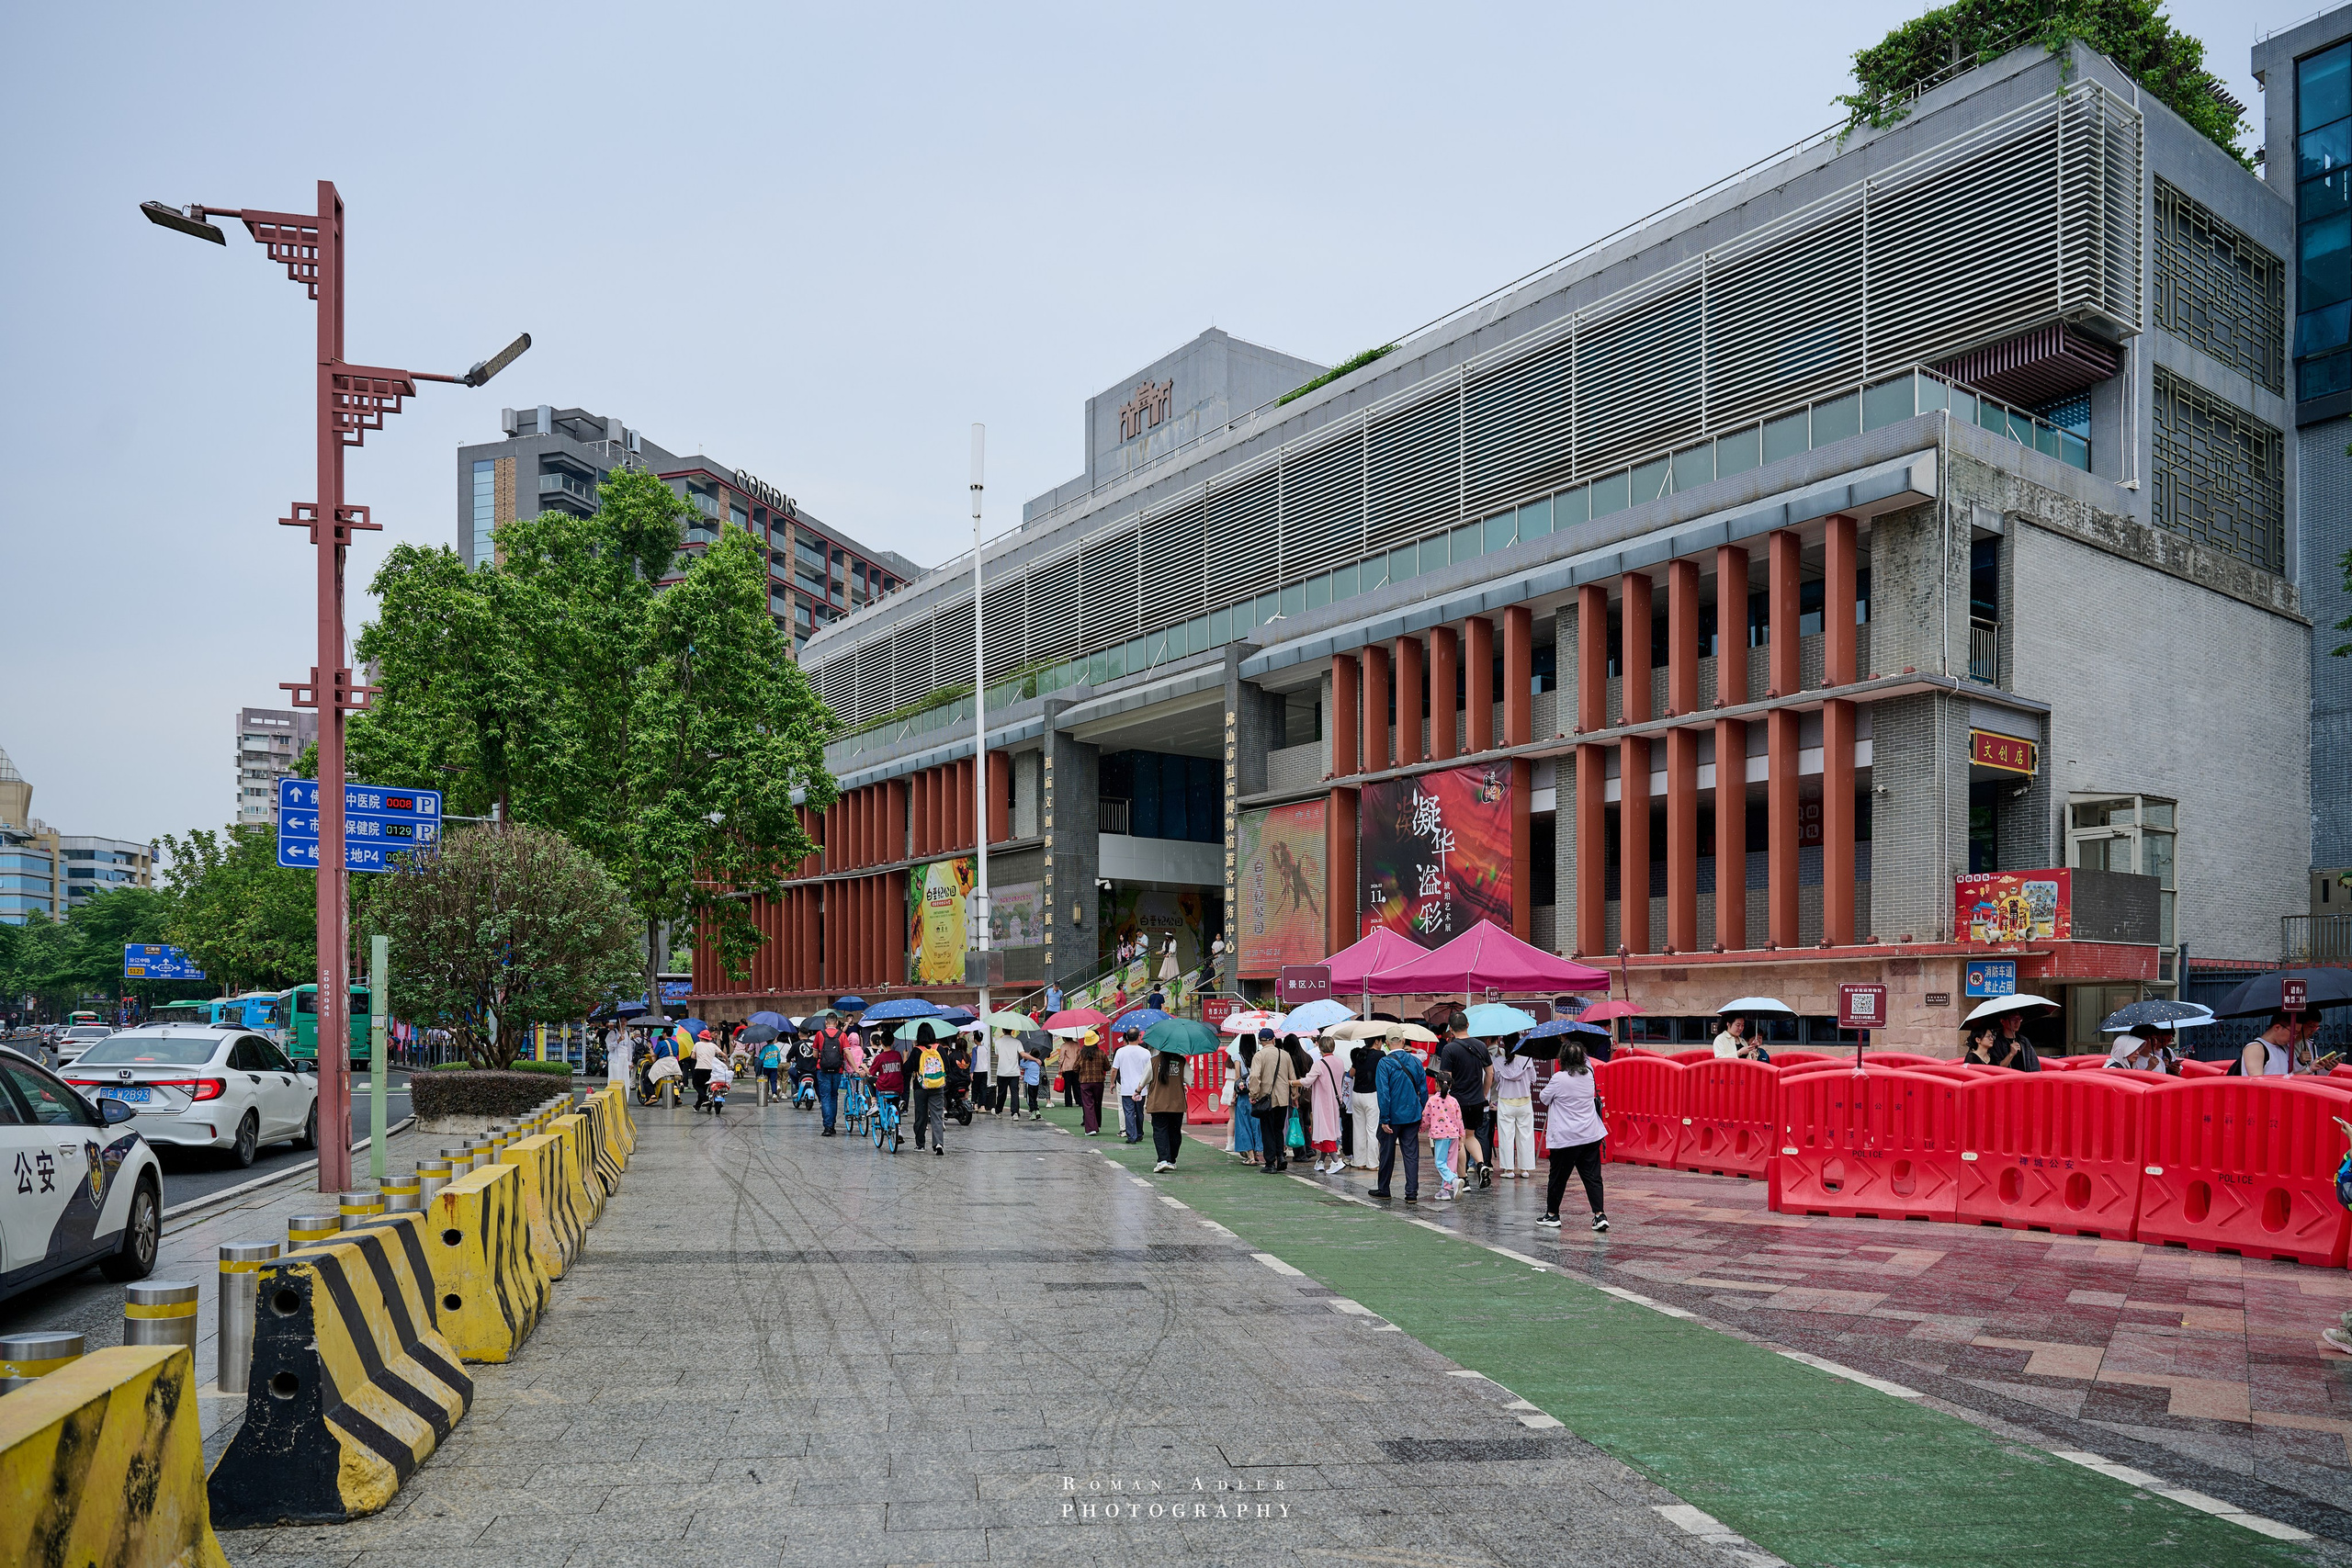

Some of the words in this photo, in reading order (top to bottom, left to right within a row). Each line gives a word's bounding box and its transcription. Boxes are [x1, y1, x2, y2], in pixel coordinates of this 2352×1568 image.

[735, 469, 797, 518] CORDIS
[1984, 740, 2023, 764] 文创店
[310, 789, 380, 809] 佛中医院
[387, 798, 412, 808] 0008
[309, 818, 379, 836] 市保健院
[386, 825, 412, 836] 0129
[1225, 712, 1236, 954] 佛山市祖庙博物馆游客服务中心
[309, 844, 379, 863] 岭地P4
[1412, 788, 1455, 935] 凝华溢彩
[927, 885, 956, 901] 白垩纪公园
[1443, 881, 1452, 932] 琥珀艺术展
[1984, 965, 2013, 977] 消防车道
[1288, 979, 1326, 989] 景区入口
[1984, 980, 2013, 994] 禁止占用
[1836, 1101, 1902, 1111] 禅城公安
[1852, 1150, 1883, 1158] POLICE
[2019, 1156, 2075, 1169] 禅城公安
[14, 1149, 56, 1195] 公安
[2219, 1174, 2254, 1184] POLICE
